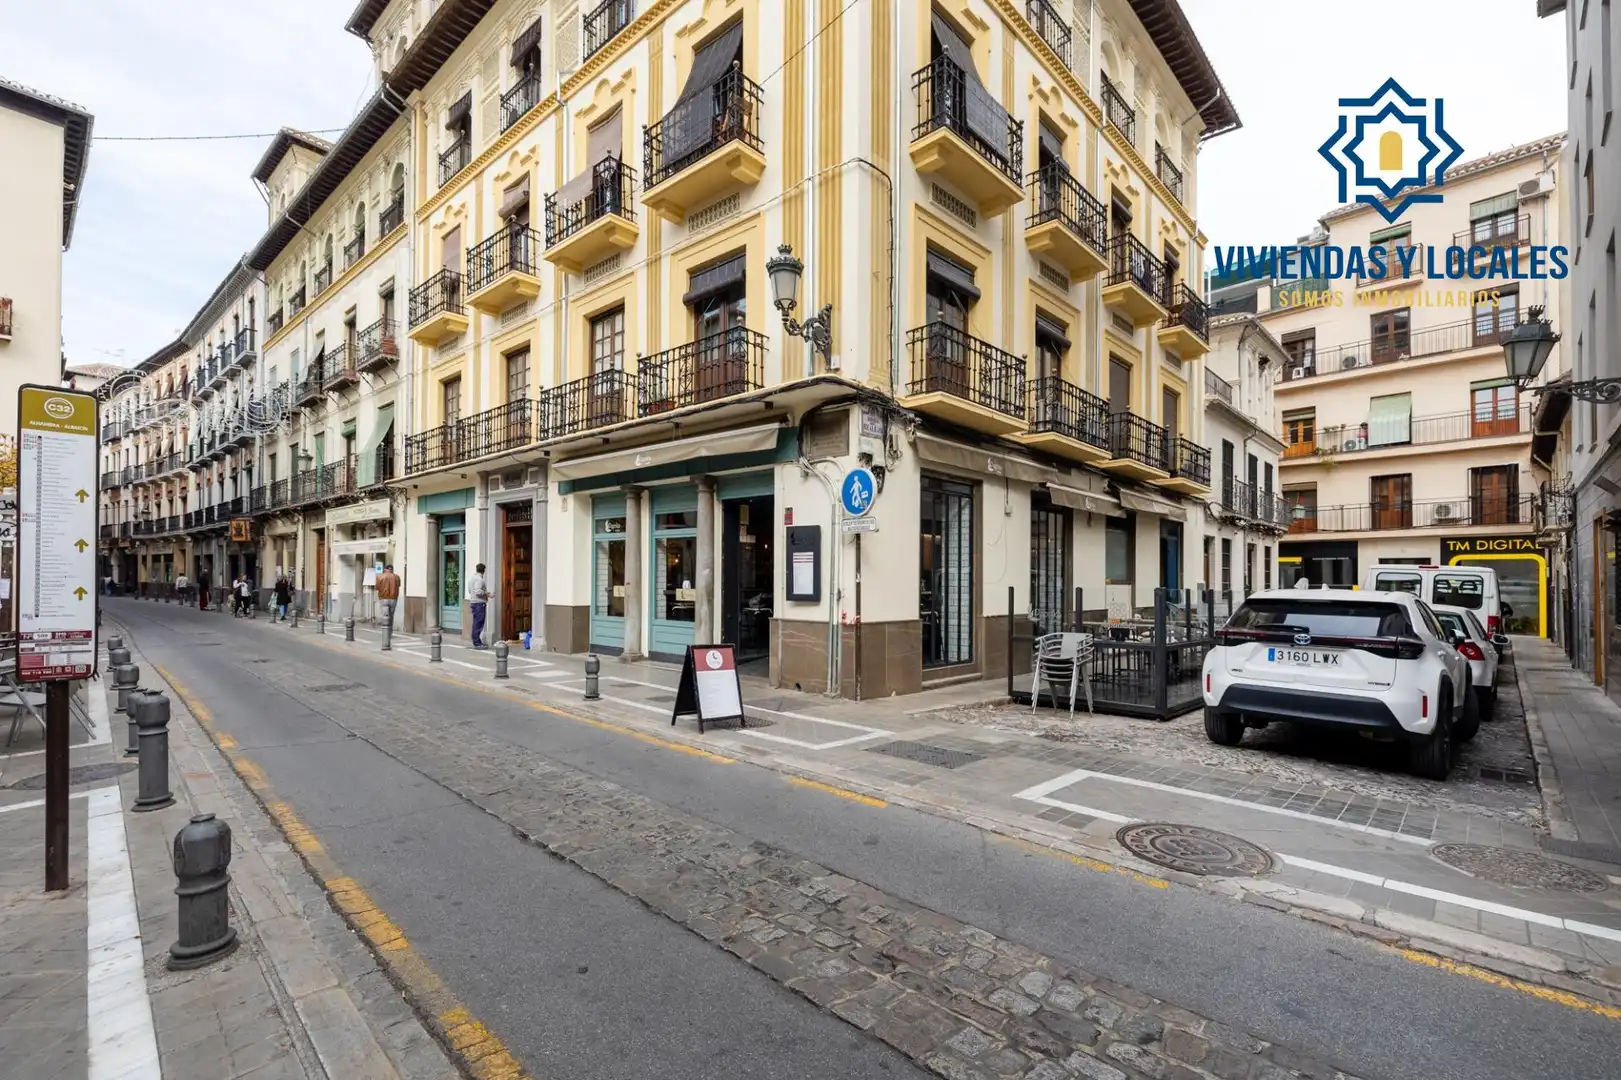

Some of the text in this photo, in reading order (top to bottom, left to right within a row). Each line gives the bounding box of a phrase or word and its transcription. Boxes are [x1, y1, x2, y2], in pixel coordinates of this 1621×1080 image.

[47, 403, 71, 413] C32
[1446, 539, 1545, 551] TM DIGITAL
[1277, 650, 1339, 665] 3160 LWX
